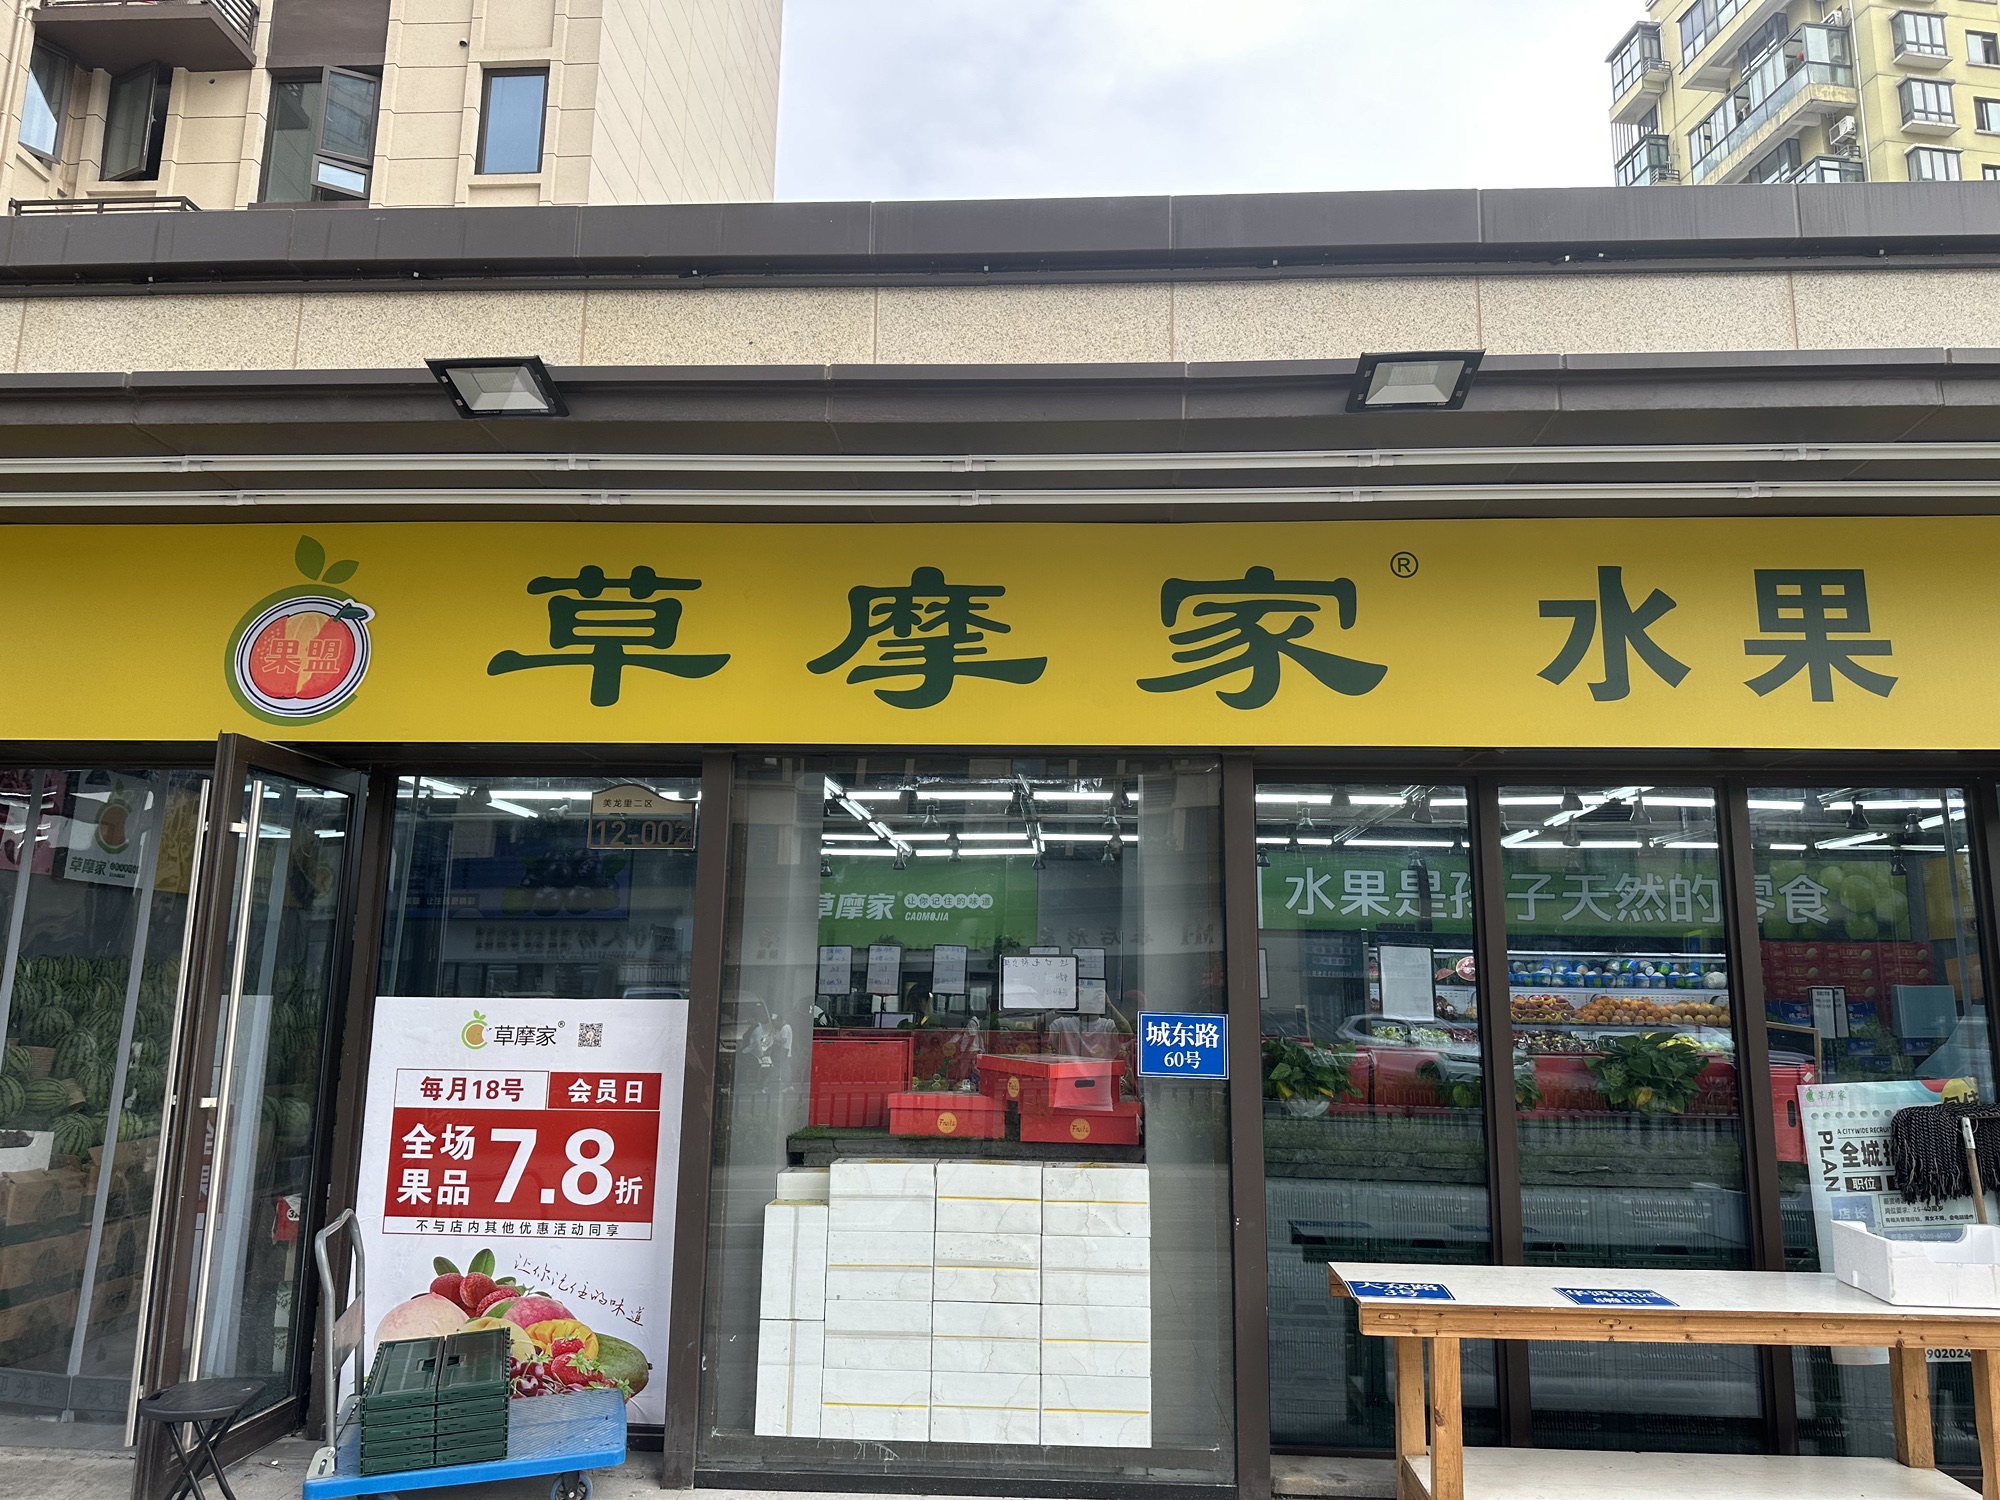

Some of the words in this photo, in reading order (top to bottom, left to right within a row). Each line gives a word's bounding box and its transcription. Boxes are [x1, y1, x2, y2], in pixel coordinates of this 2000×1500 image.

[487, 565, 1388, 710] 草摩家
[1536, 565, 1899, 702] 水果
[262, 638, 343, 674] 果盟
[603, 798, 653, 808] 美龙里二区
[595, 820, 692, 846] 12-002
[69, 856, 107, 876] 草摩家
[905, 893, 992, 908] 让你记住的味道
[493, 1024, 558, 1047] 草摩家
[1146, 1020, 1220, 1049] 城东路
[1163, 1051, 1202, 1070] 60号
[419, 1076, 524, 1102] 每月18号
[567, 1078, 644, 1104] 会员日
[401, 1122, 476, 1161] 全场
[1818, 1130, 1841, 1192] PLAN
[397, 1167, 470, 1206] 果品
[1851, 1177, 1876, 1191] 职位
[1838, 1206, 1868, 1219] 店长
[415, 1218, 621, 1237] 不与店内其他优惠活动同享
[1926, 1348, 1971, 1359] 902024
